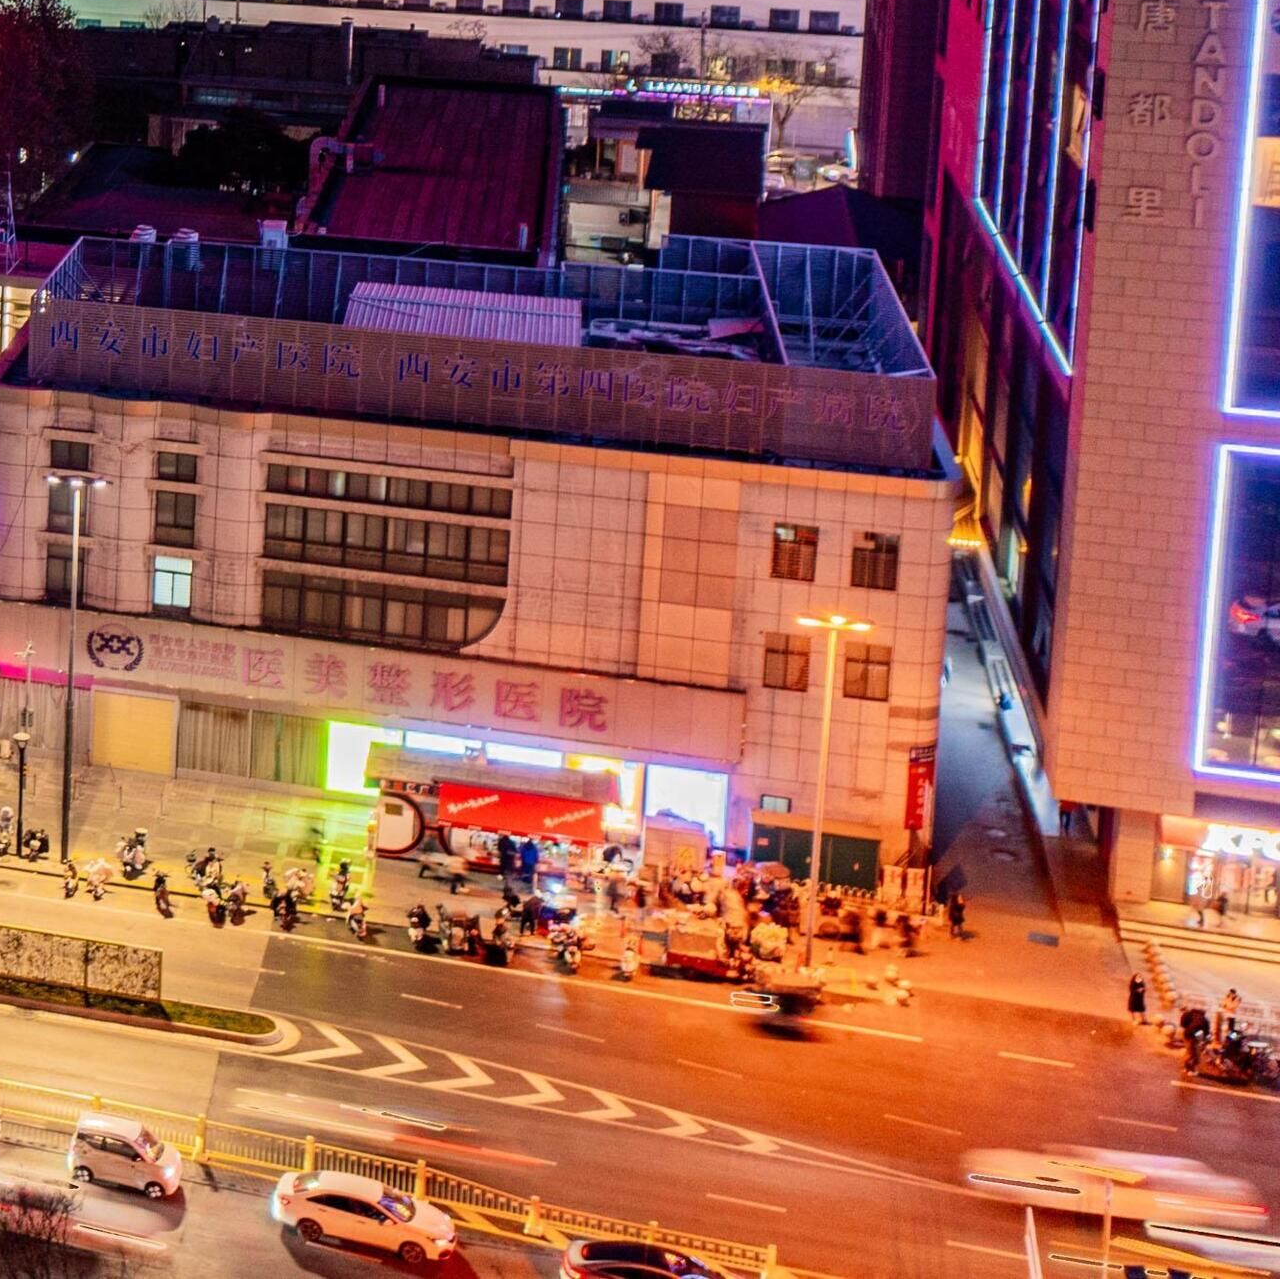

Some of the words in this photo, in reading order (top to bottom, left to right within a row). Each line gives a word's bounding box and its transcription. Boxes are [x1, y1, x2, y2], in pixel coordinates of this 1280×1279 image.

[1187, 0, 1229, 227] TANDOLI
[243, 646, 609, 733] 医美整形医院
